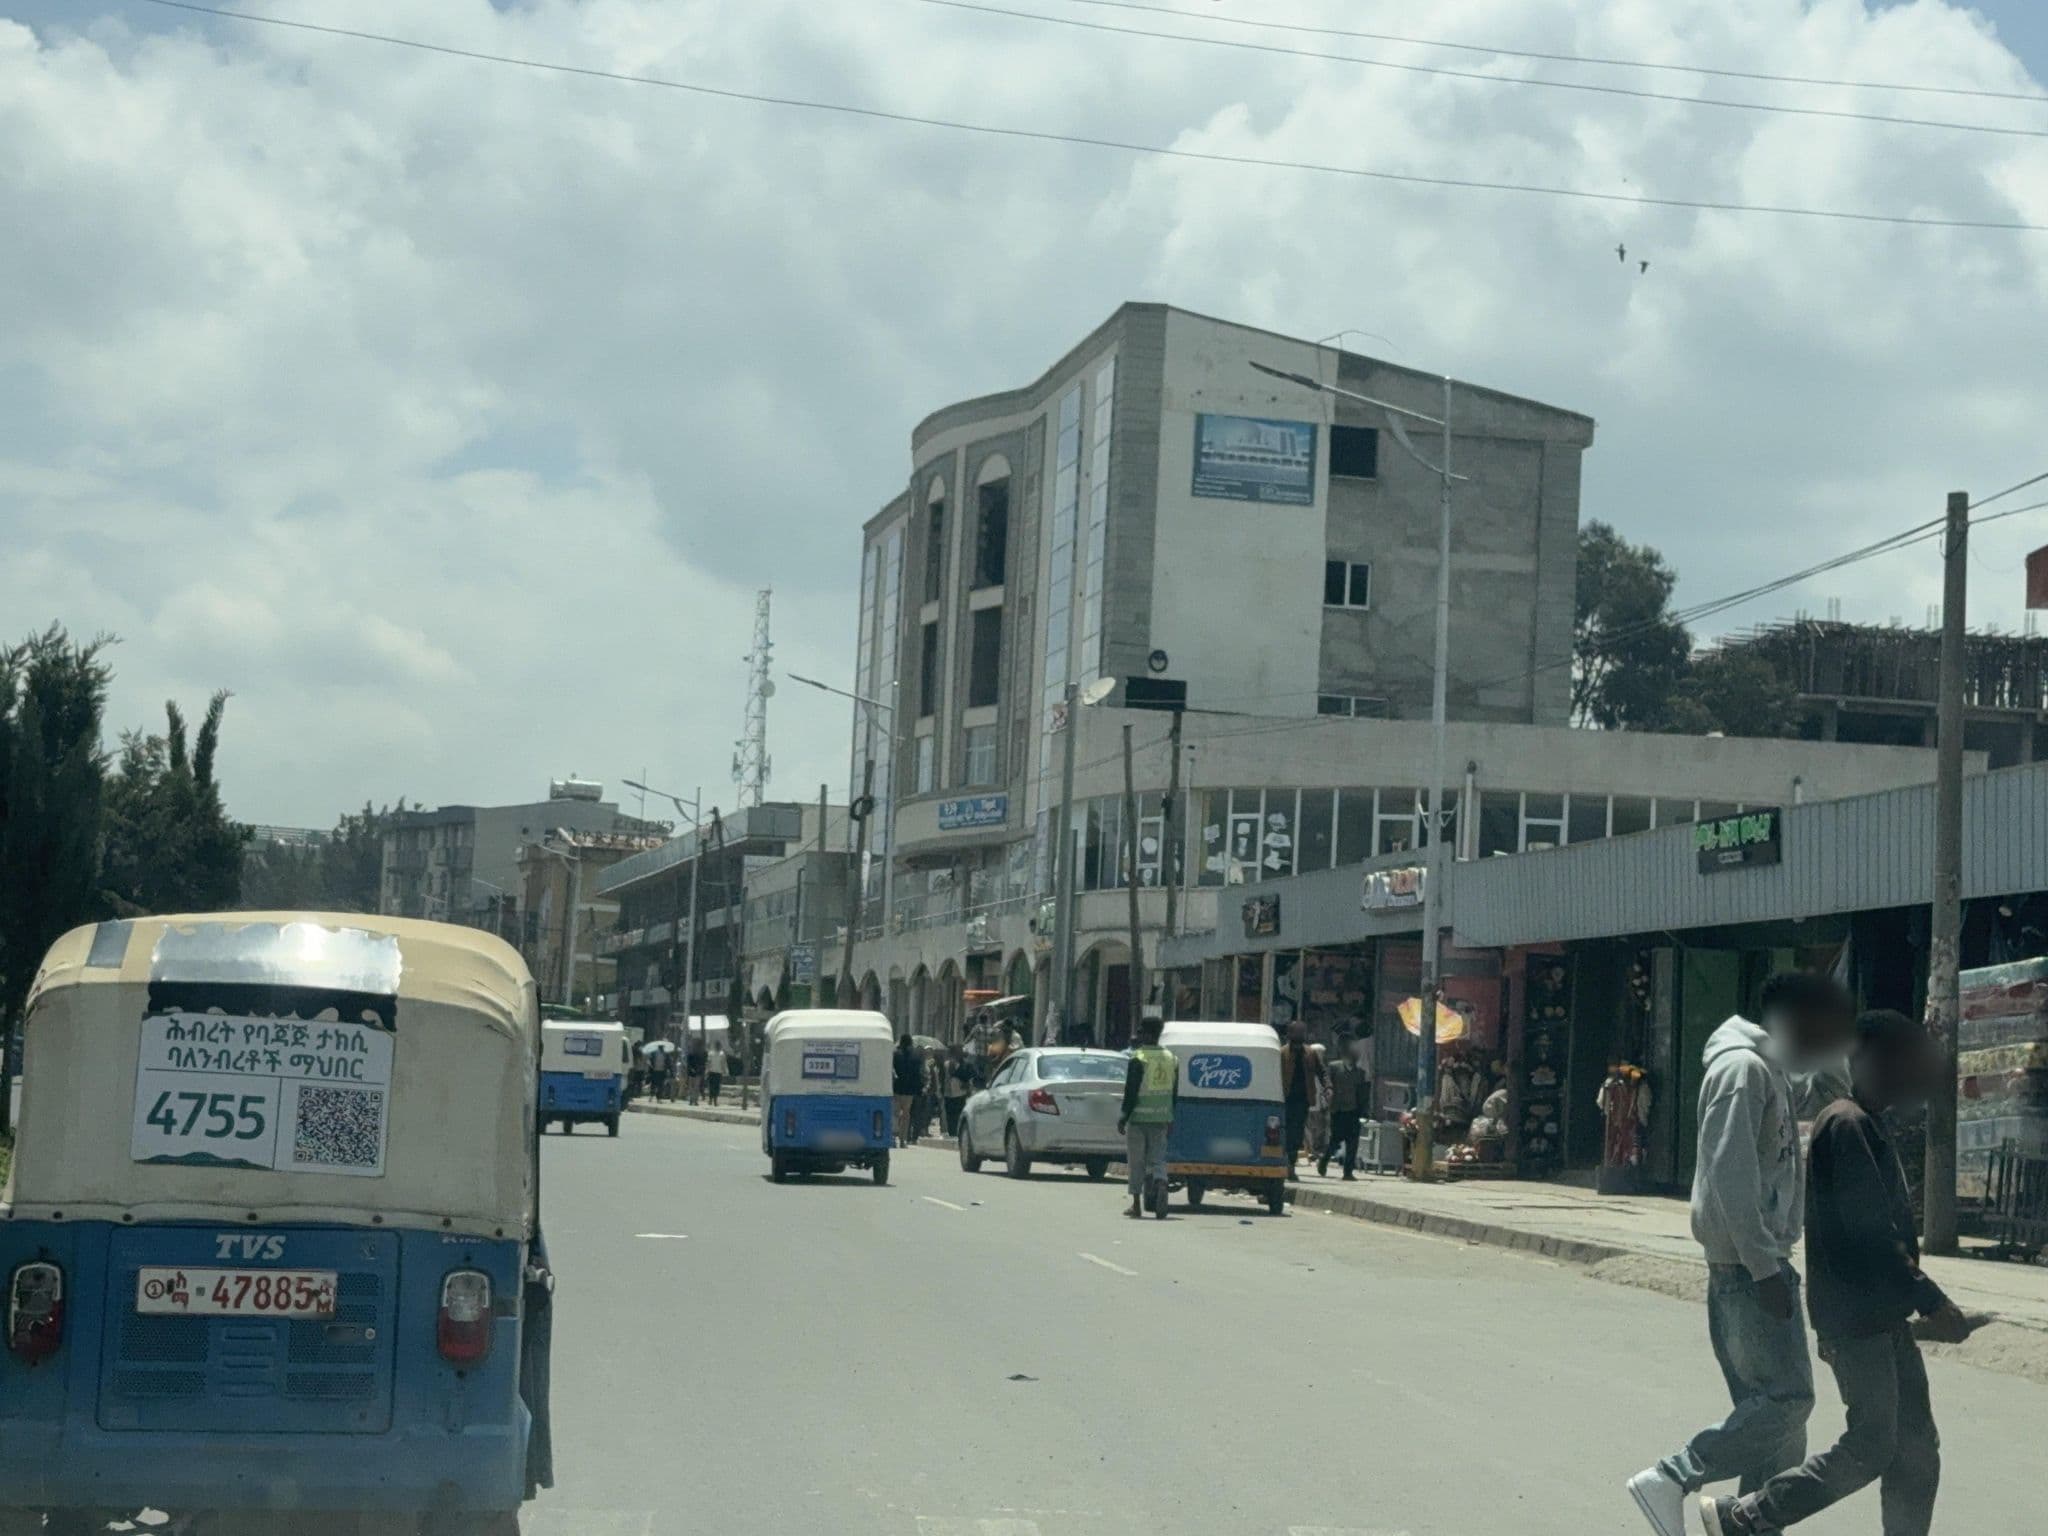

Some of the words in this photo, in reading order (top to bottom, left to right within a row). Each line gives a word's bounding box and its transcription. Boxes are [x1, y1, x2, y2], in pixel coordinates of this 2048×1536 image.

[166, 1018, 235, 1044] ሕብረት
[242, 1023, 310, 1048] የባጃጅ
[316, 1028, 369, 1053] ታክሲ
[168, 1046, 282, 1073] ባለንብረቶች
[289, 1053, 364, 1080] ማህበር
[146, 1091, 266, 1140] 4755
[215, 1234, 286, 1260] TVS
[211, 1275, 314, 1311] 47885
